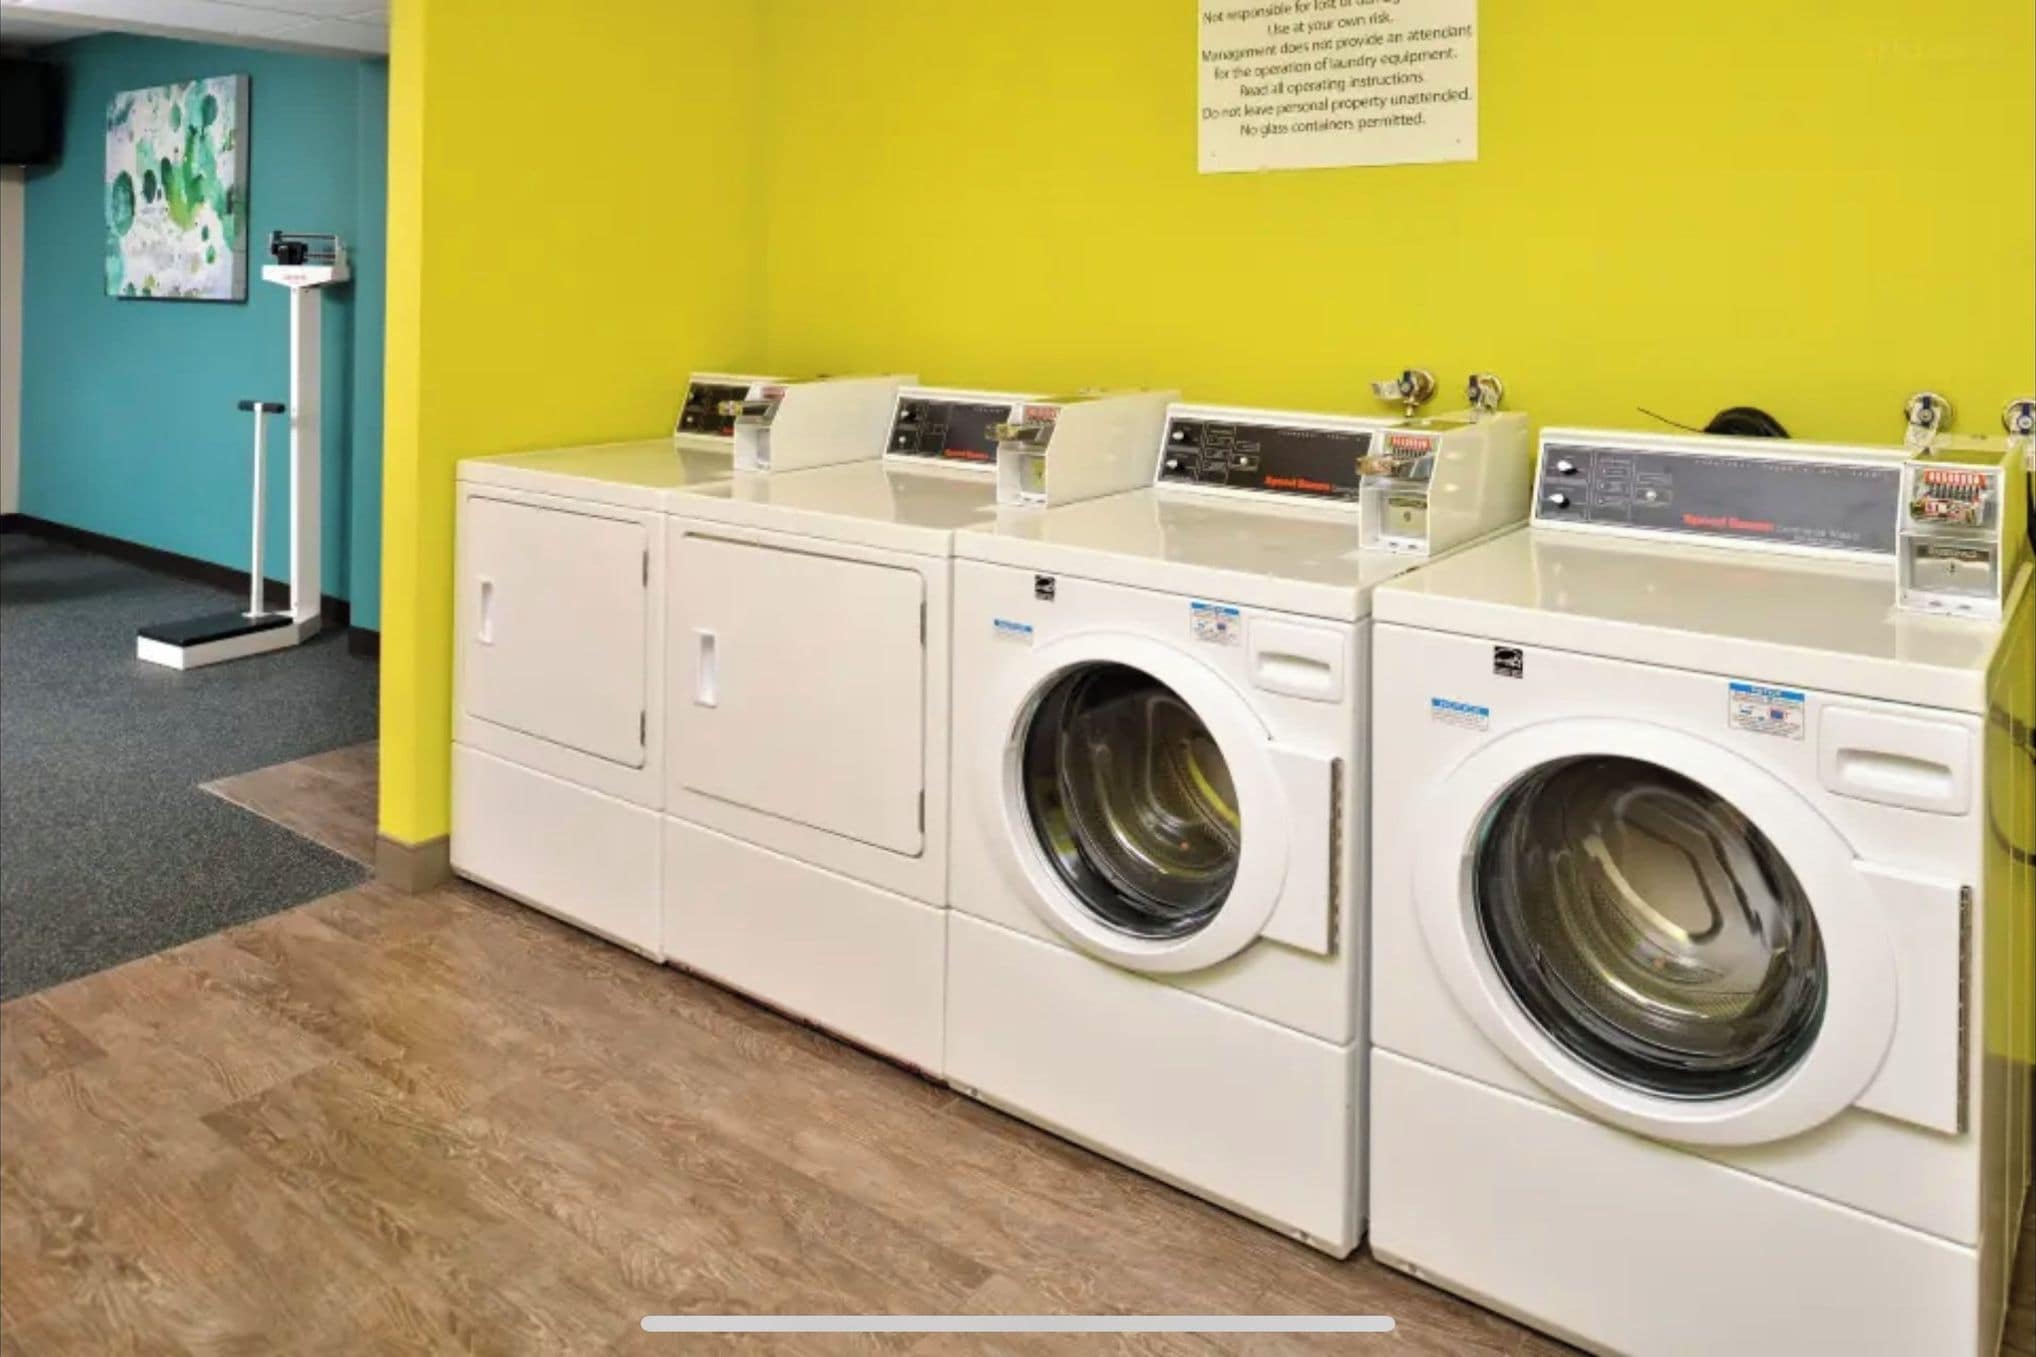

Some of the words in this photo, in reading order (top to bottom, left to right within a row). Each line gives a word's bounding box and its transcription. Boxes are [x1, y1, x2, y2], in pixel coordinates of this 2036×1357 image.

[1203, 12, 1224, 24] Not
[1226, 4, 1292, 22] responsible
[1294, 0, 1310, 13] for
[1267, 23, 1290, 35] Use
[1293, 21, 1305, 33] at
[1307, 20, 1335, 35] your
[1337, 16, 1366, 28] own
[1202, 45, 1277, 61] Management
[1280, 41, 1310, 54] does
[1312, 39, 1333, 51] not
[1335, 33, 1384, 51] provide
[1386, 32, 1402, 43] an
[1407, 25, 1472, 41] attendant
[1214, 67, 1230, 80] for
[1232, 66, 1252, 79] the
[1254, 62, 1312, 79] operation
[1314, 57, 1328, 71] of
[1329, 54, 1377, 70] laundry
[1240, 83, 1268, 97] Read
[1270, 81, 1284, 95] all
[1286, 77, 1346, 95] operating
[1202, 107, 1220, 120] Do
[1221, 106, 1241, 118] not
[1244, 103, 1274, 117] leave
[1276, 96, 1328, 116] personal
[1331, 94, 1388, 113] property
[1240, 123, 1258, 136] No
[1260, 122, 1289, 138] glass
[1291, 117, 1353, 133] containers
